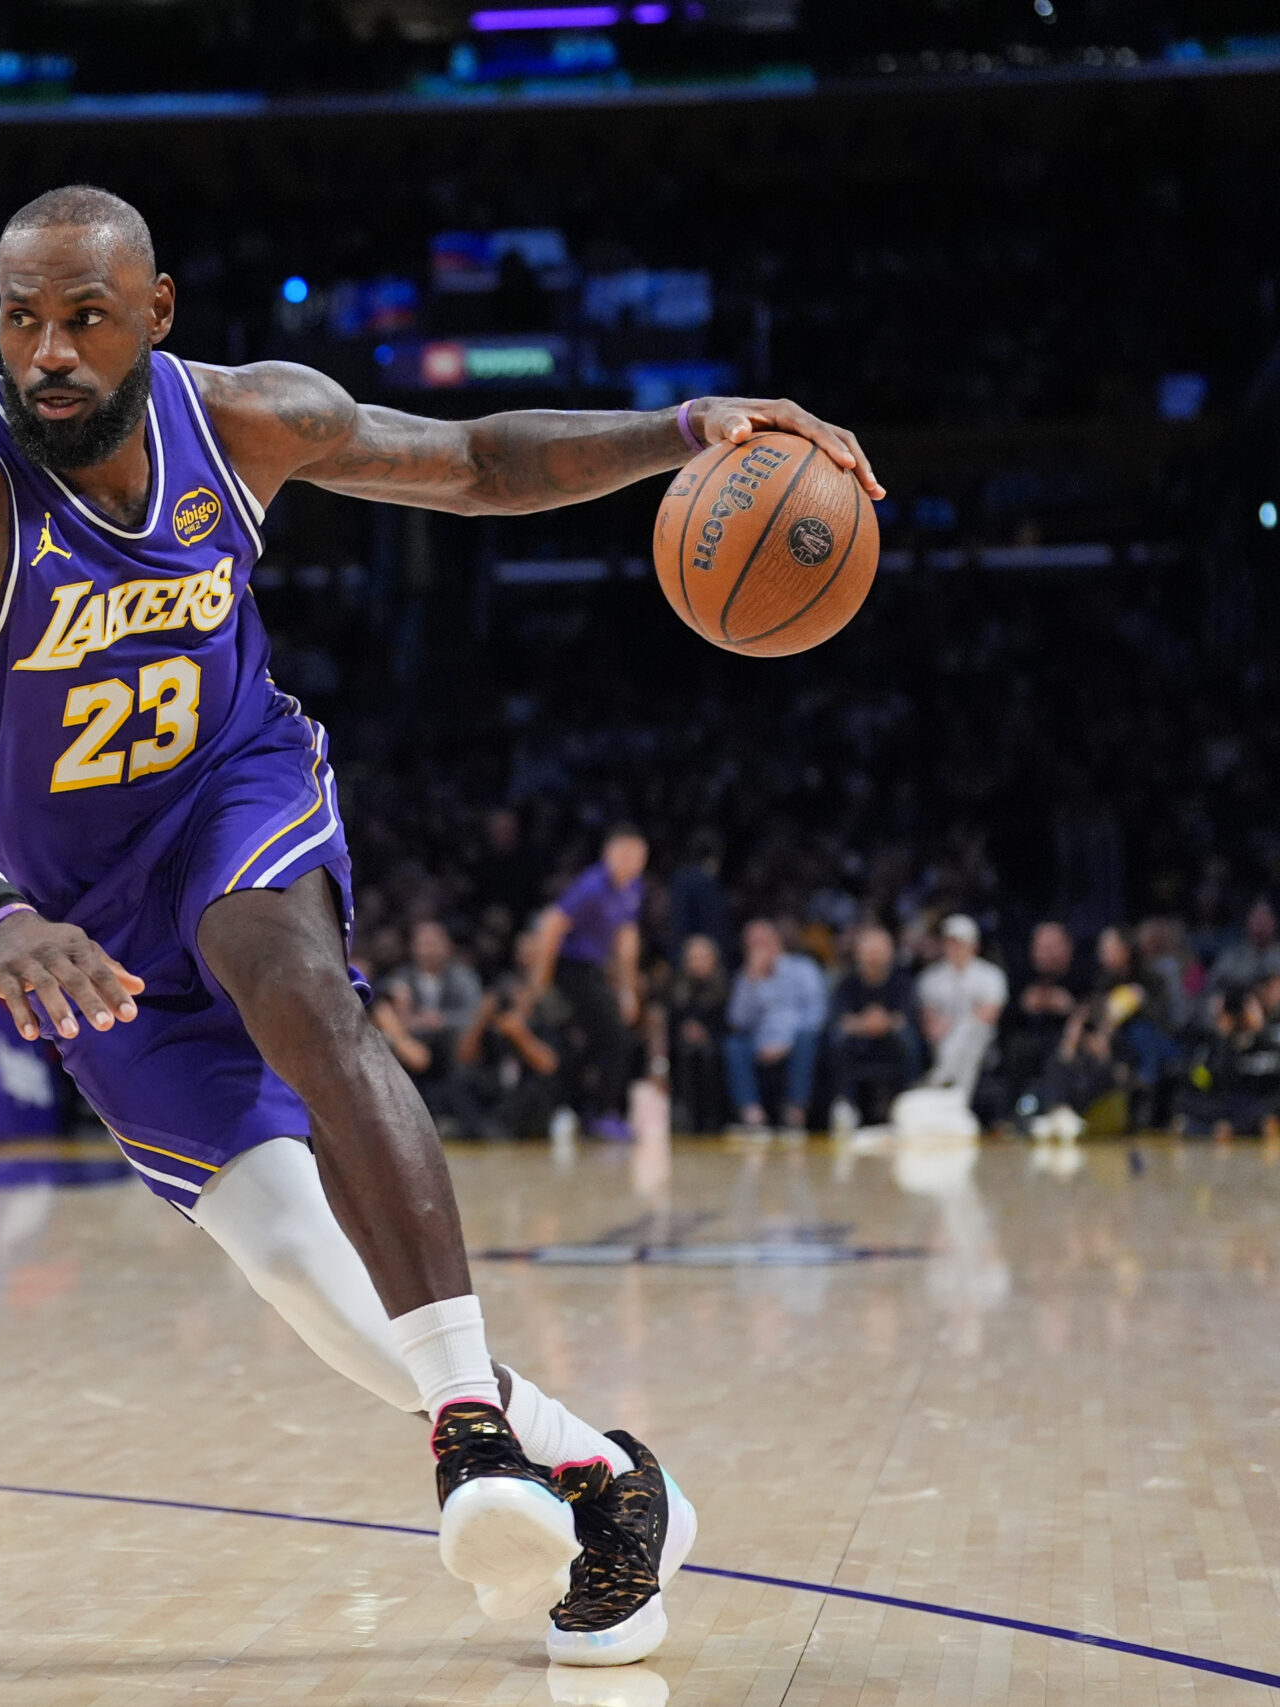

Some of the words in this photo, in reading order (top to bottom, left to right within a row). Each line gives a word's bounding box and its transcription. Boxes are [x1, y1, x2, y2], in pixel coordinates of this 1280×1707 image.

[175, 501, 217, 531] bibigo
[693, 446, 792, 572] Wilson
[12, 557, 234, 671] LAKERS
[50, 655, 202, 794] 23
